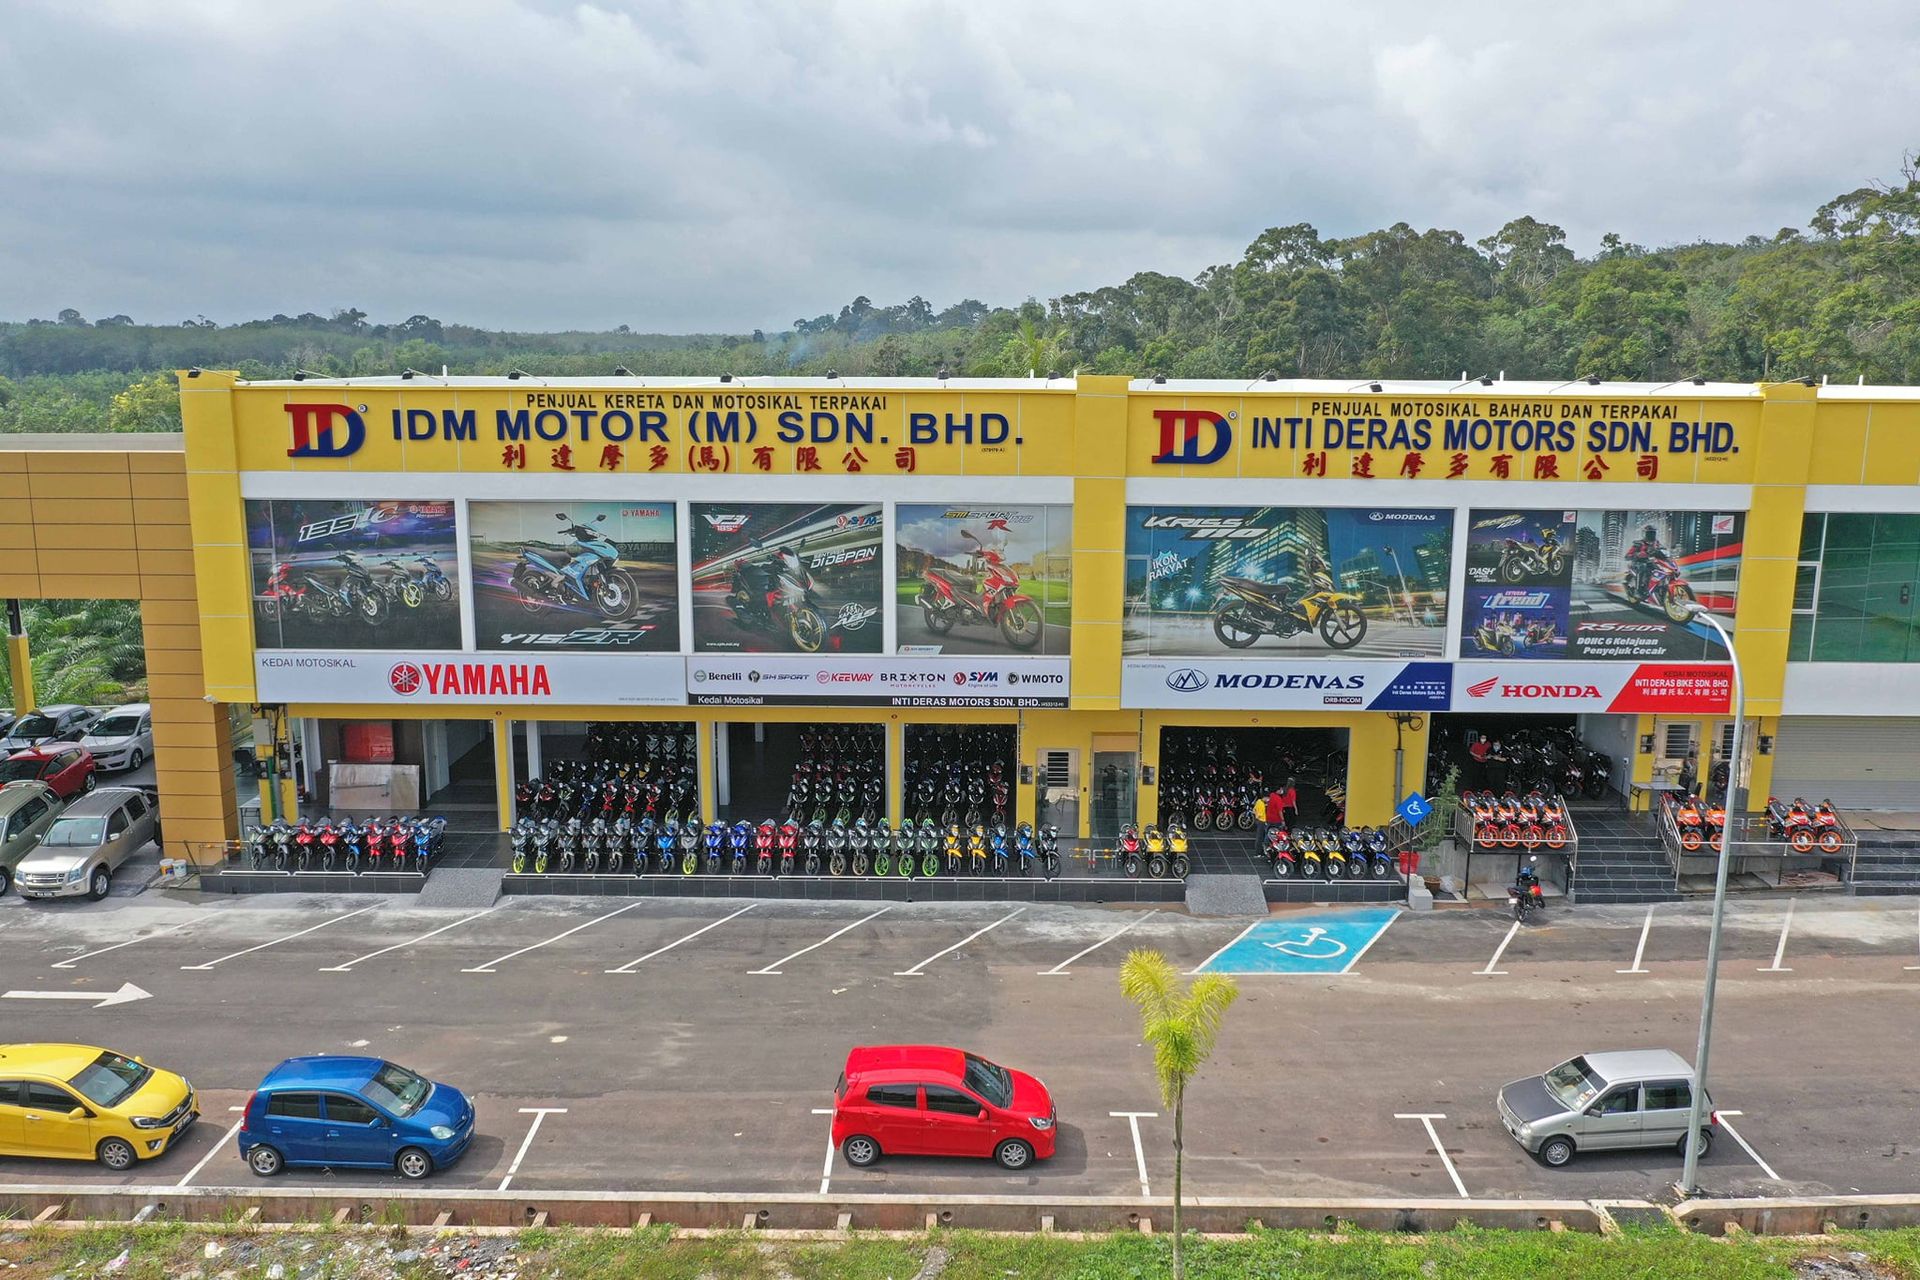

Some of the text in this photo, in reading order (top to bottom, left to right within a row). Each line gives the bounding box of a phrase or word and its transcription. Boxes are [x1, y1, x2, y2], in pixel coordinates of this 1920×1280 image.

[526, 393, 887, 410] PENJUAL KERETA DAN MOTOSIKAL TERPAKAI
[1311, 402, 1678, 419] PENJUAL MOTOSIKAL BAHARU DAN TERPAKAI
[391, 408, 1023, 445] IDM MOTOR (M) SDN. BHD.
[1252, 416, 1739, 453] INTI DERAS MOTORS SDN. BHD.
[630, 509, 661, 518] YAMAHA
[1384, 513, 1437, 521] MODENAS
[850, 515, 877, 526] SYM
[1144, 516, 1244, 528] KRISS
[1190, 528, 1269, 538] 110
[1152, 552, 1179, 570] IKON
[1149, 558, 1189, 581] RAKYAT
[1468, 567, 1497, 576] DASH
[1576, 637, 1605, 645] DOHC
[1613, 637, 1659, 647] Kelajuan
[1583, 646, 1667, 656] Penyejuk Cecair
[261, 658, 357, 668] KEDAI MOTOSIKAL
[422, 663, 552, 696] YAMAHA
[708, 672, 742, 681] Benelli
[830, 673, 874, 682] KEEWAY
[880, 672, 946, 682] BRIXTON
[968, 671, 999, 682] SYM
[1021, 674, 1064, 684] WMOTO
[1213, 673, 1365, 690] MODENAS
[1635, 679, 1730, 688] INTI DERAS BIKE SDN. BHD.
[1501, 684, 1603, 698] HONDA
[697, 695, 764, 705] Kedai Motosikal
[892, 697, 911, 706] INTI
[912, 697, 947, 706] DERAS
[949, 698, 992, 707] MOTORS
[993, 698, 1016, 707] SDN.
[1018, 698, 1041, 707] BHD.
